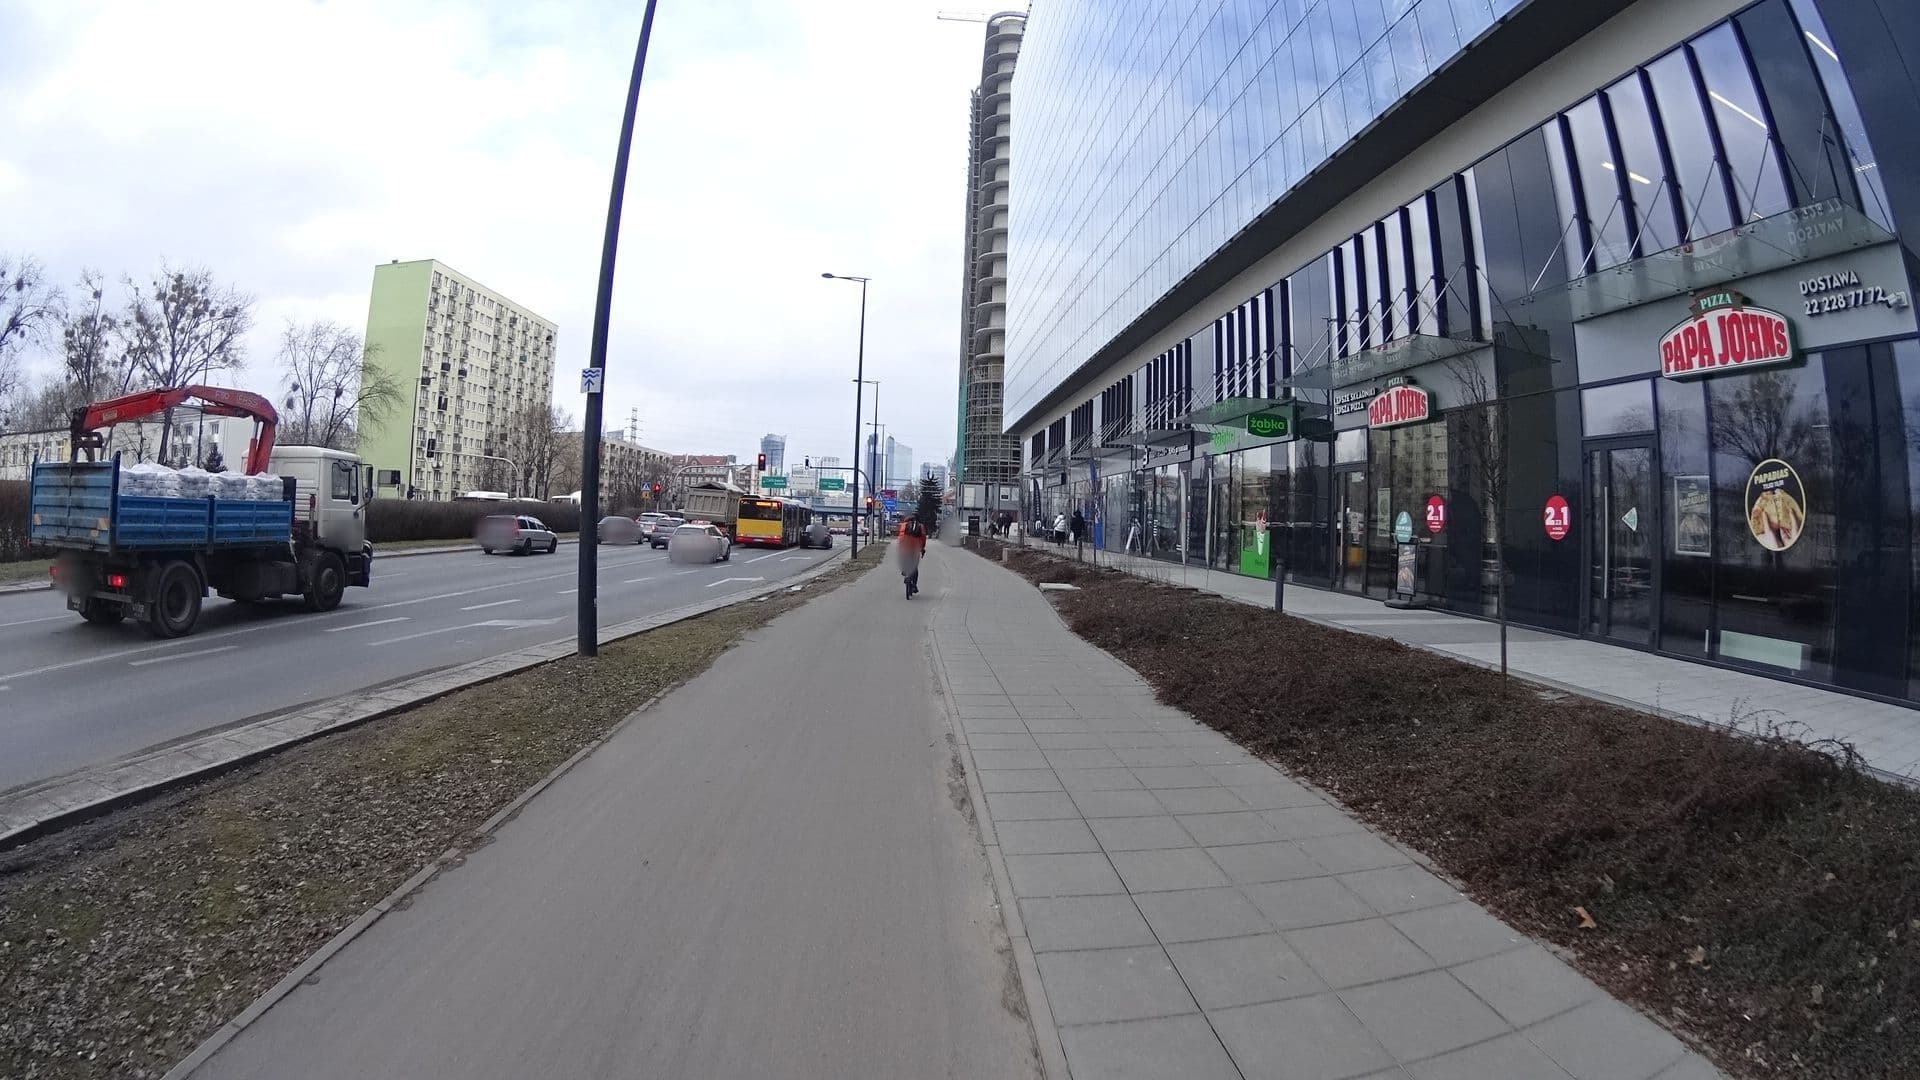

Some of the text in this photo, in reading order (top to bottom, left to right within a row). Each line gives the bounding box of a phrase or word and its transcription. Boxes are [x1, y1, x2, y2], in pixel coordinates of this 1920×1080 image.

[1800, 271, 1858, 294] DOSTAWA
[1700, 293, 1732, 309] PIZZA
[1804, 299, 1819, 314] 22
[1822, 294, 1846, 312] 228
[1848, 290, 1863, 307] 77
[1663, 320, 1716, 373] PAPA
[1388, 377, 1403, 387] PIZZA
[1369, 393, 1393, 425] PAPA
[1250, 417, 1285, 430] żabka
[1753, 468, 1789, 485] PAPADIAS
